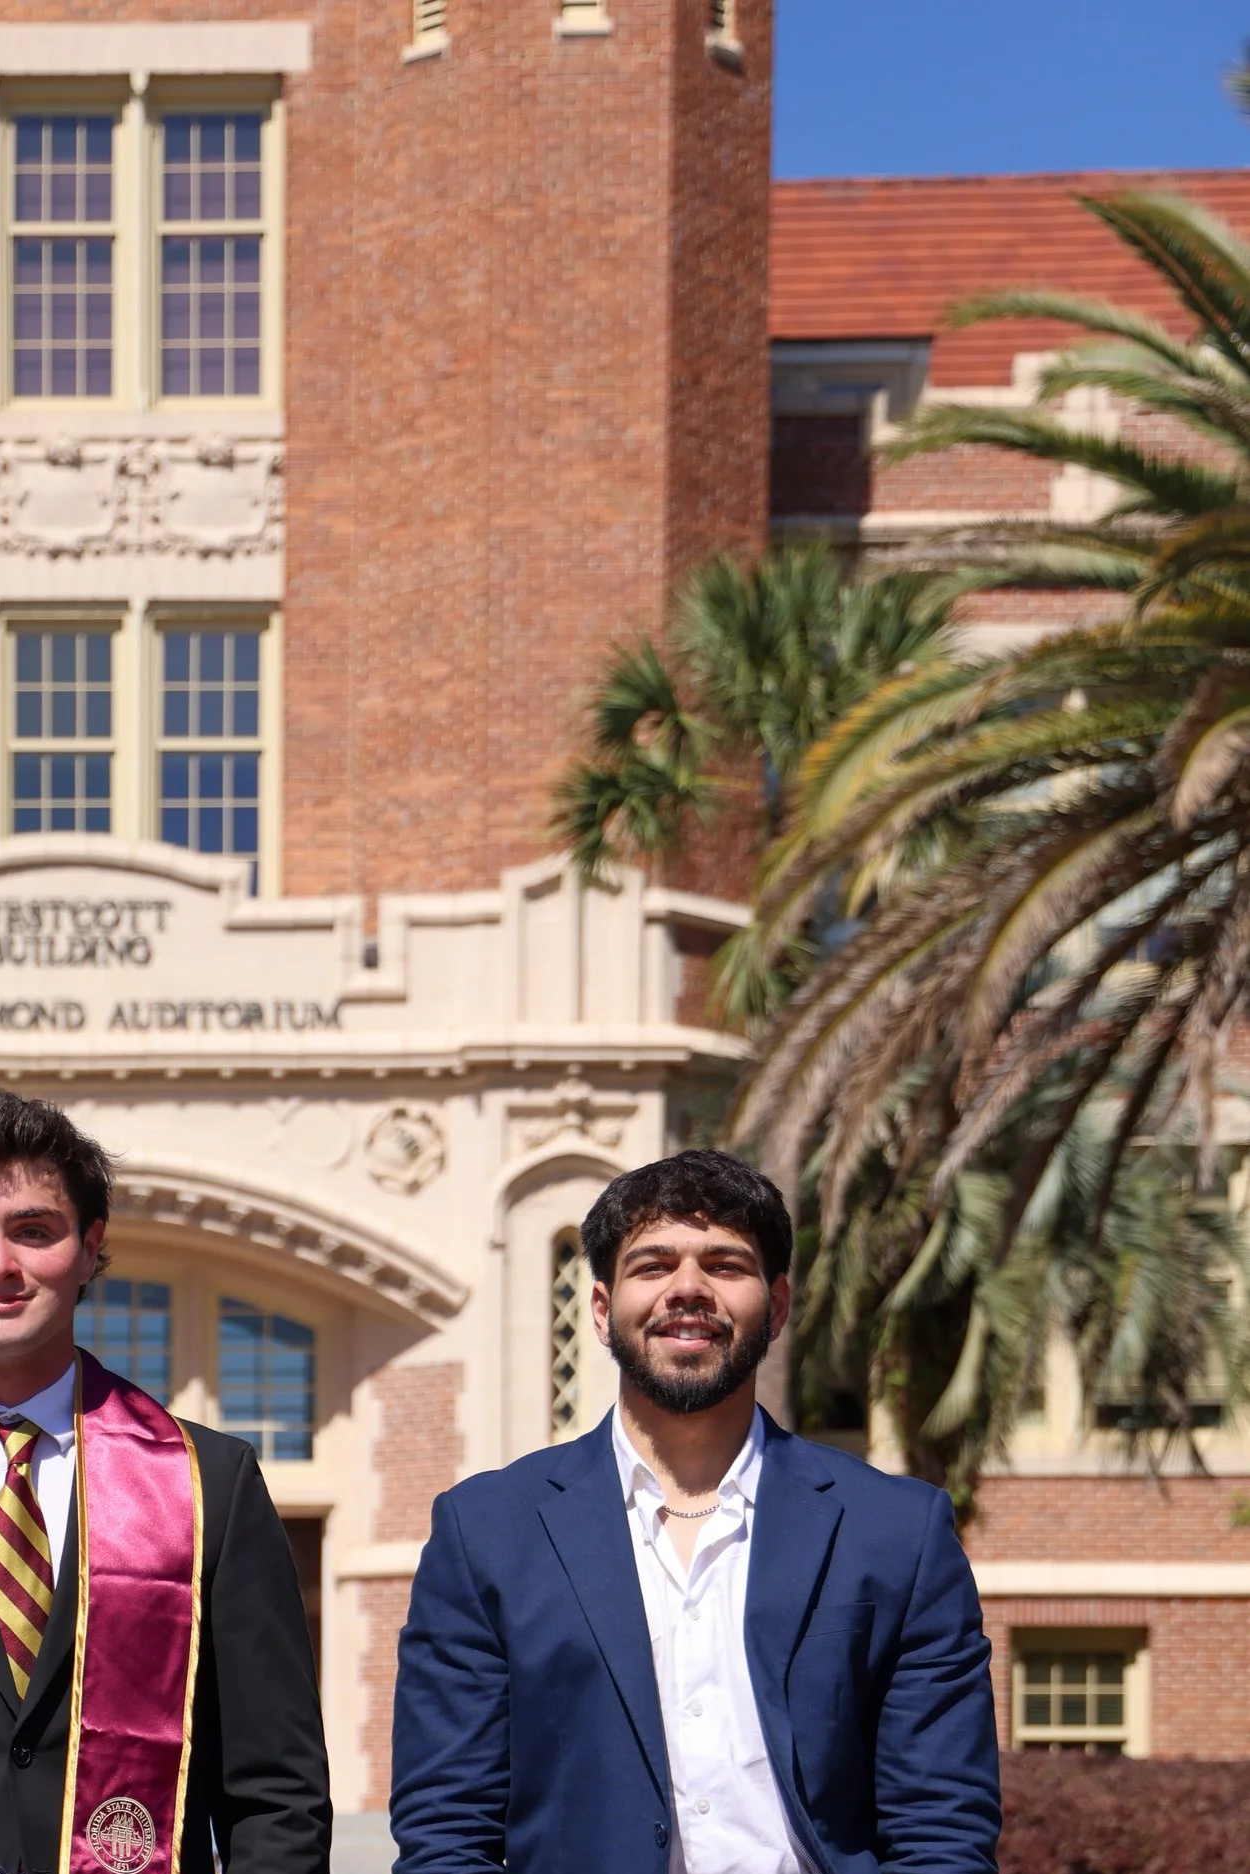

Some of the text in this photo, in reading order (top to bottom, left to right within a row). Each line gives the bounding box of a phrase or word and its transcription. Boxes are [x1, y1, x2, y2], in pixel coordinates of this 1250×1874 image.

[107, 1000, 343, 1032] AUDITORIUM
[91, 1801, 151, 1861] FLORIDA STATE UNIVERSITY
[113, 1860, 130, 1871] 1851
